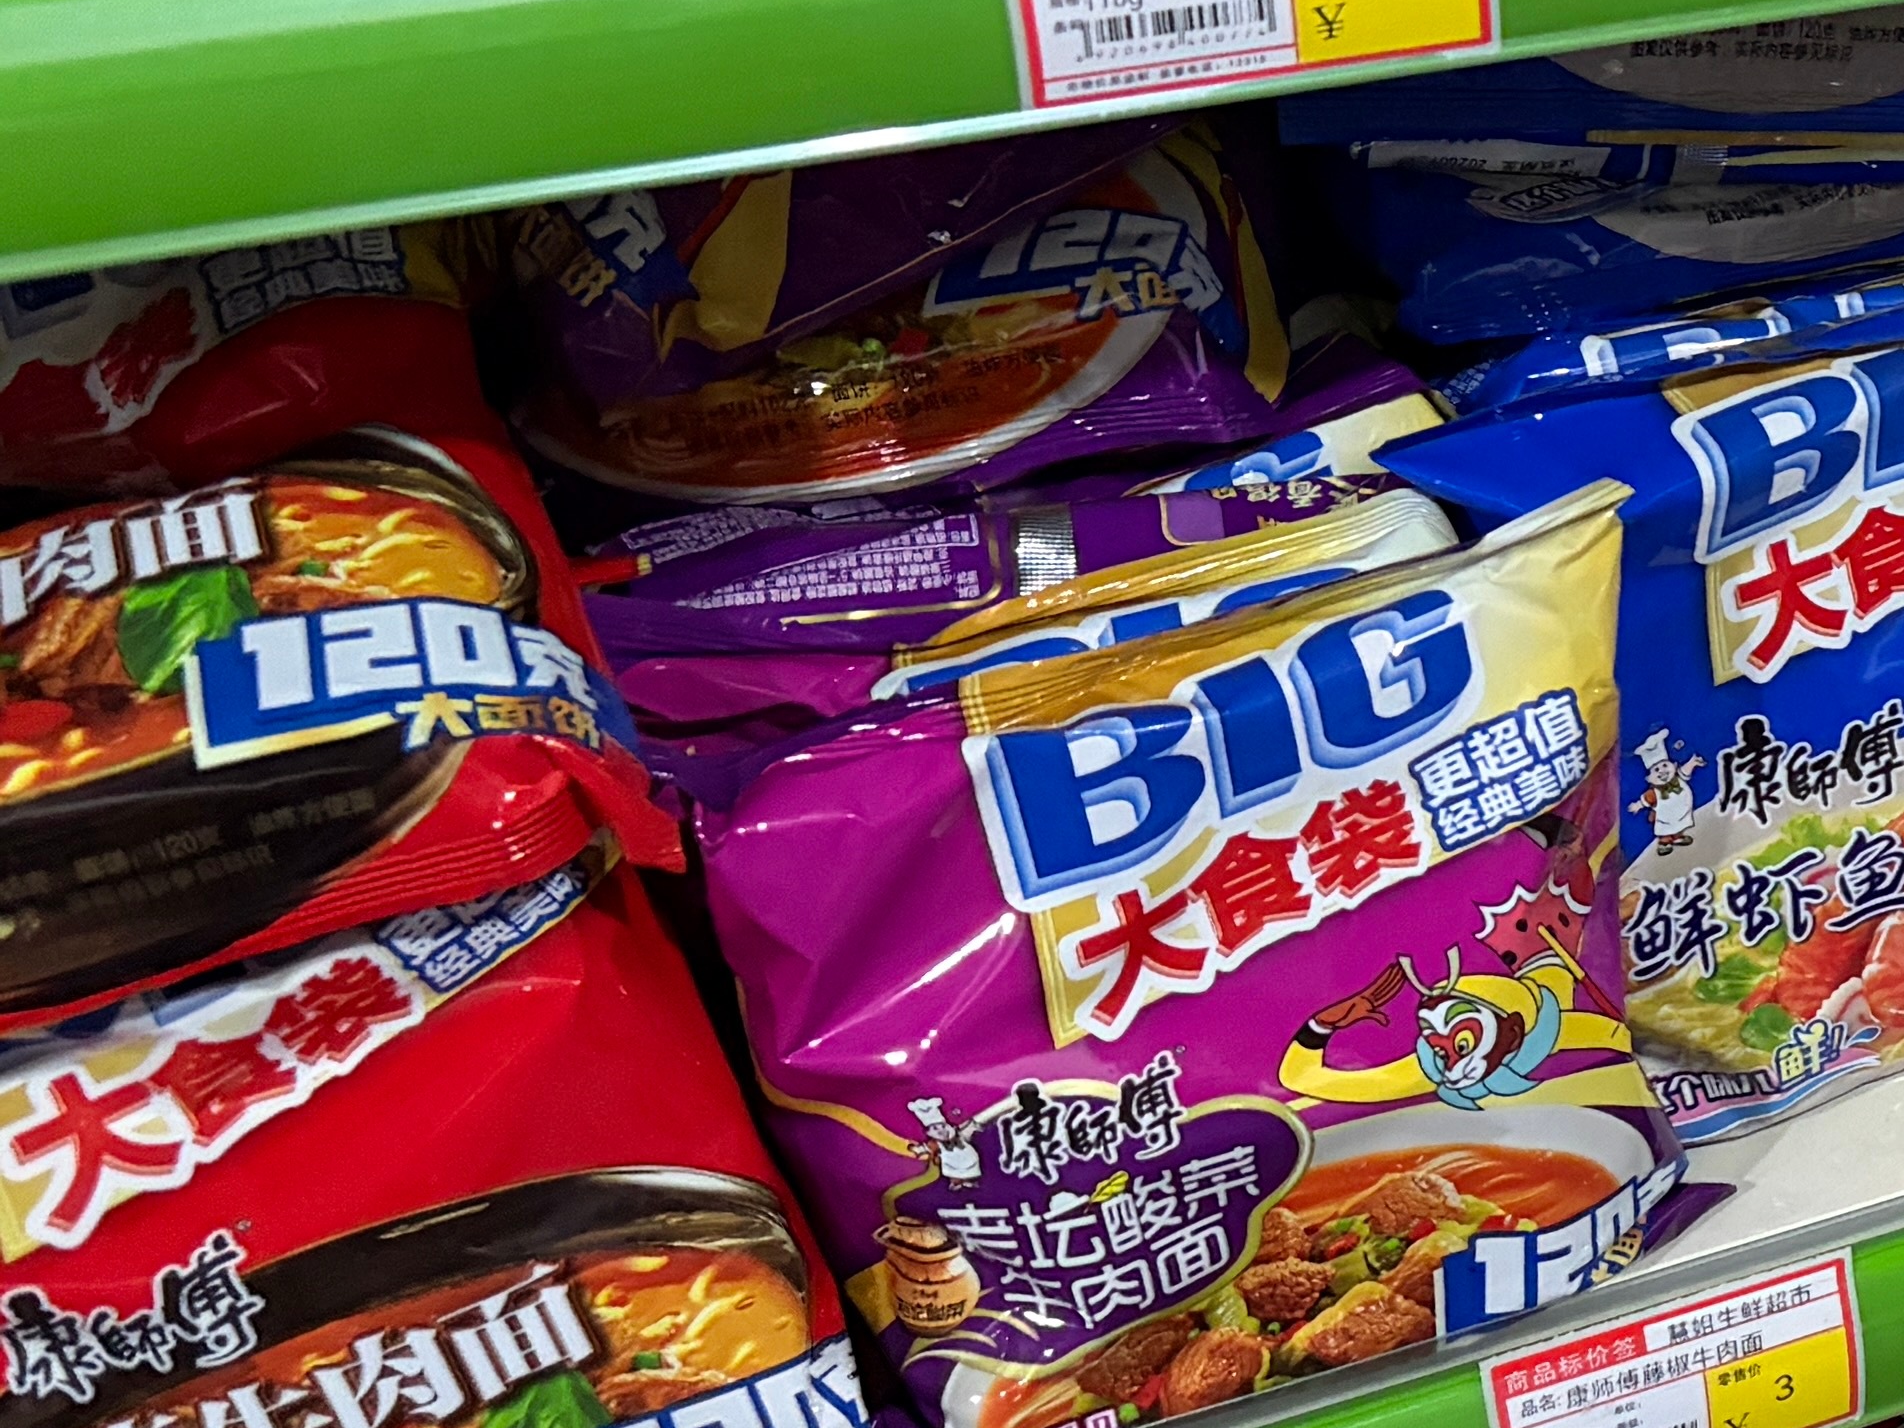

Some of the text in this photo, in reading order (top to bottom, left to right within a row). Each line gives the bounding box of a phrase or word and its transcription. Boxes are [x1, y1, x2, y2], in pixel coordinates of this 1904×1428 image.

[1313, 3, 1347, 42] ¥
[242, 600, 600, 712] 120克
[980, 585, 1480, 904] BIG
[1413, 691, 1586, 804] 更超值
[1437, 746, 1590, 848] 经典美味
[1076, 779, 1426, 1026] 大食袋
[12, 952, 422, 1234] 大食袋
[998, 1052, 1186, 1184] 康師傅
[937, 1143, 1262, 1279] 老坛酸菜
[1002, 1213, 1236, 1328] 牛肉面
[1504, 1338, 1638, 1395] 商品标价签
[1717, 1365, 1762, 1387] 零售价
[1774, 1374, 1796, 1402] 3
